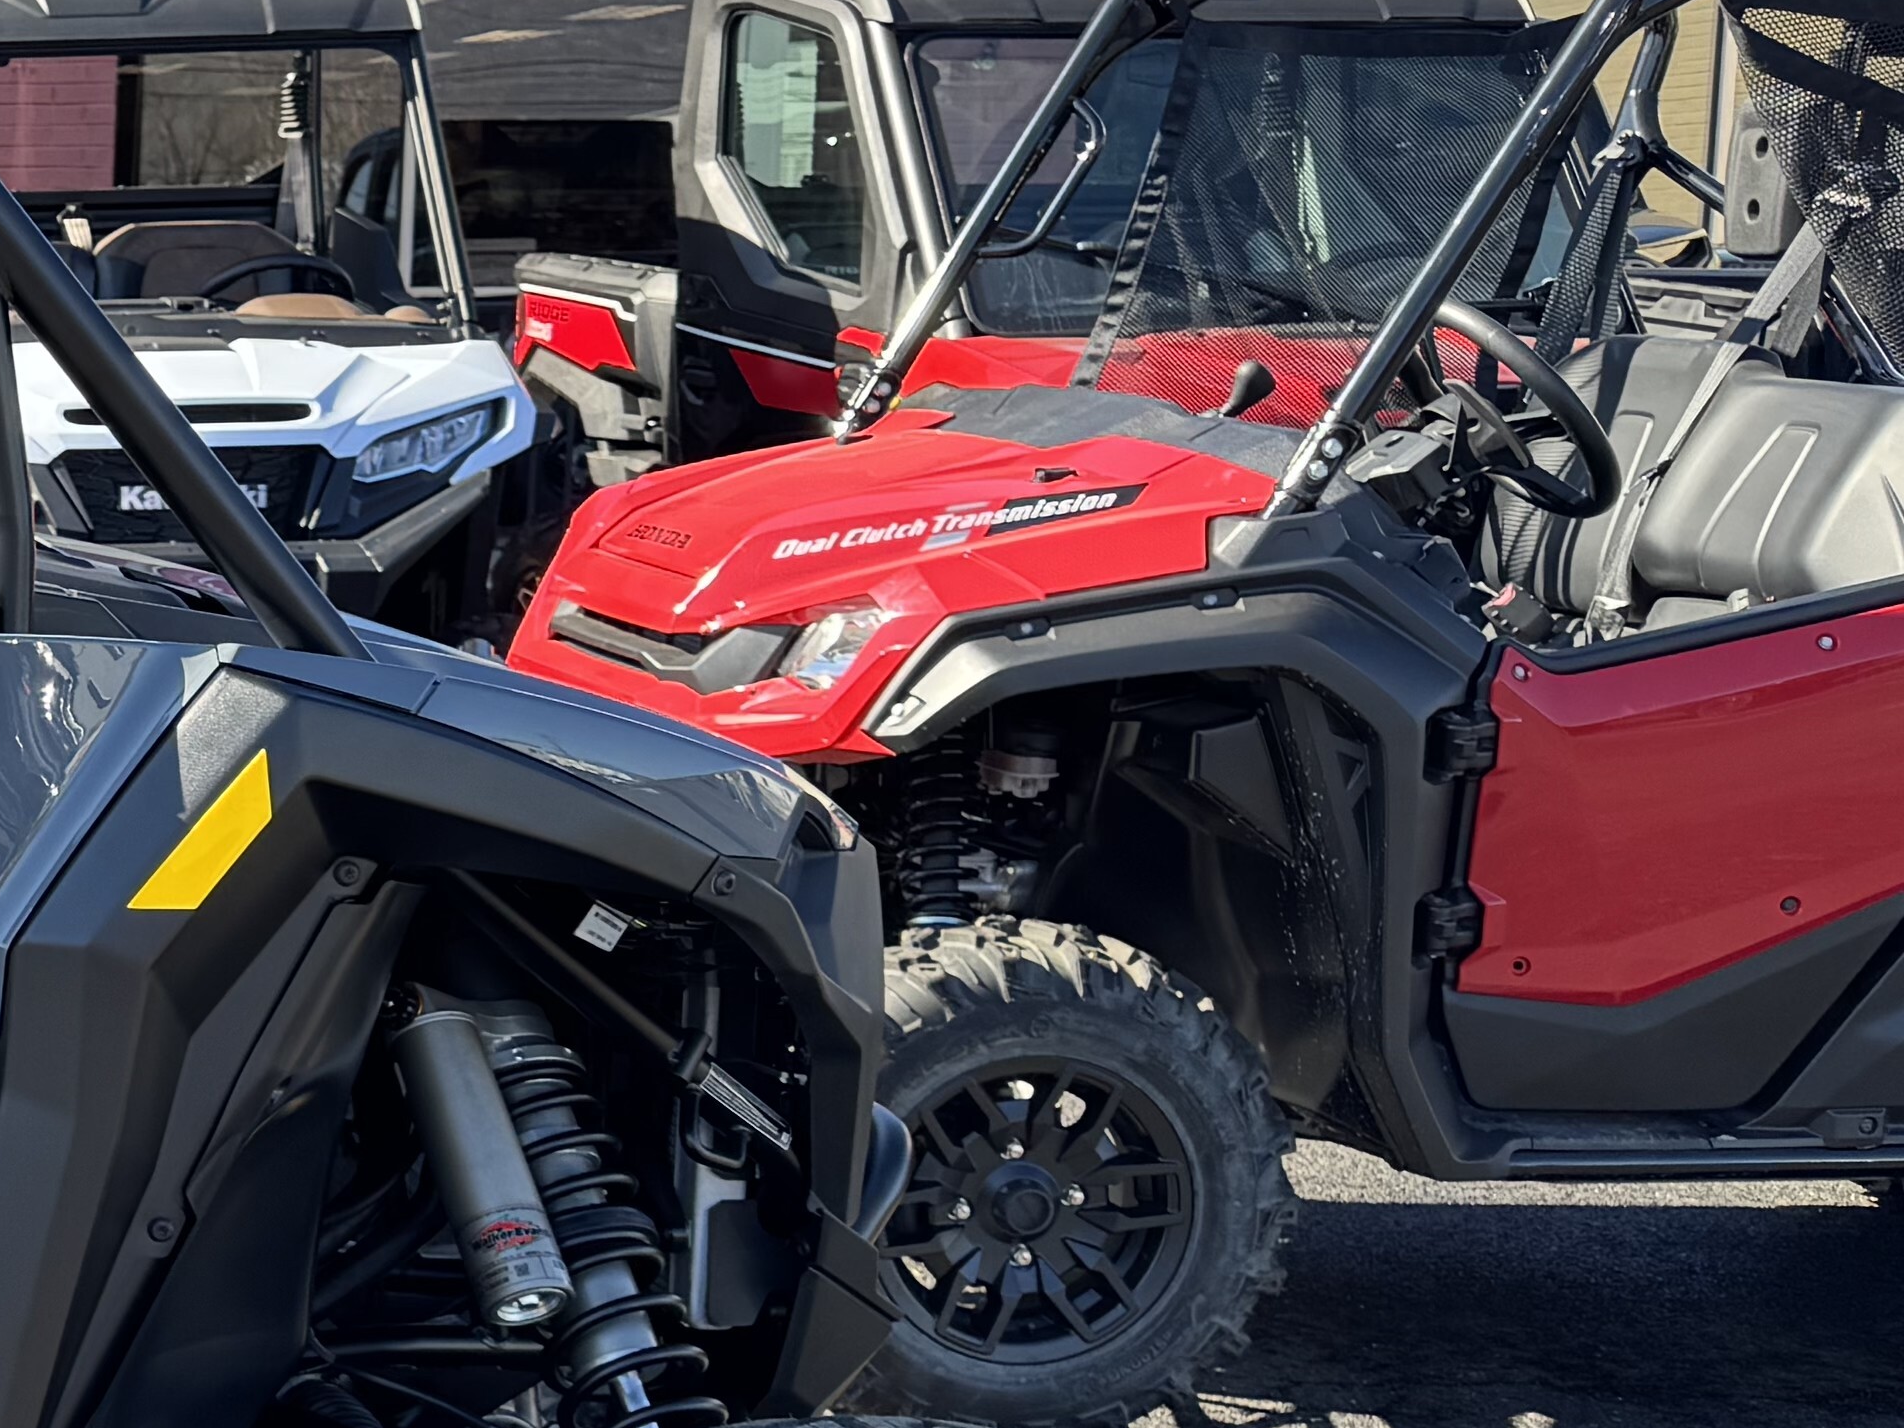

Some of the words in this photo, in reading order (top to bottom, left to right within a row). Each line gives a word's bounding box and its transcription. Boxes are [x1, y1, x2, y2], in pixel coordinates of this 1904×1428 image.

[626, 522, 692, 551] HONDA
[771, 531, 839, 560] Dual
[840, 518, 927, 550] Clutch
[931, 490, 1118, 535] Transmission
